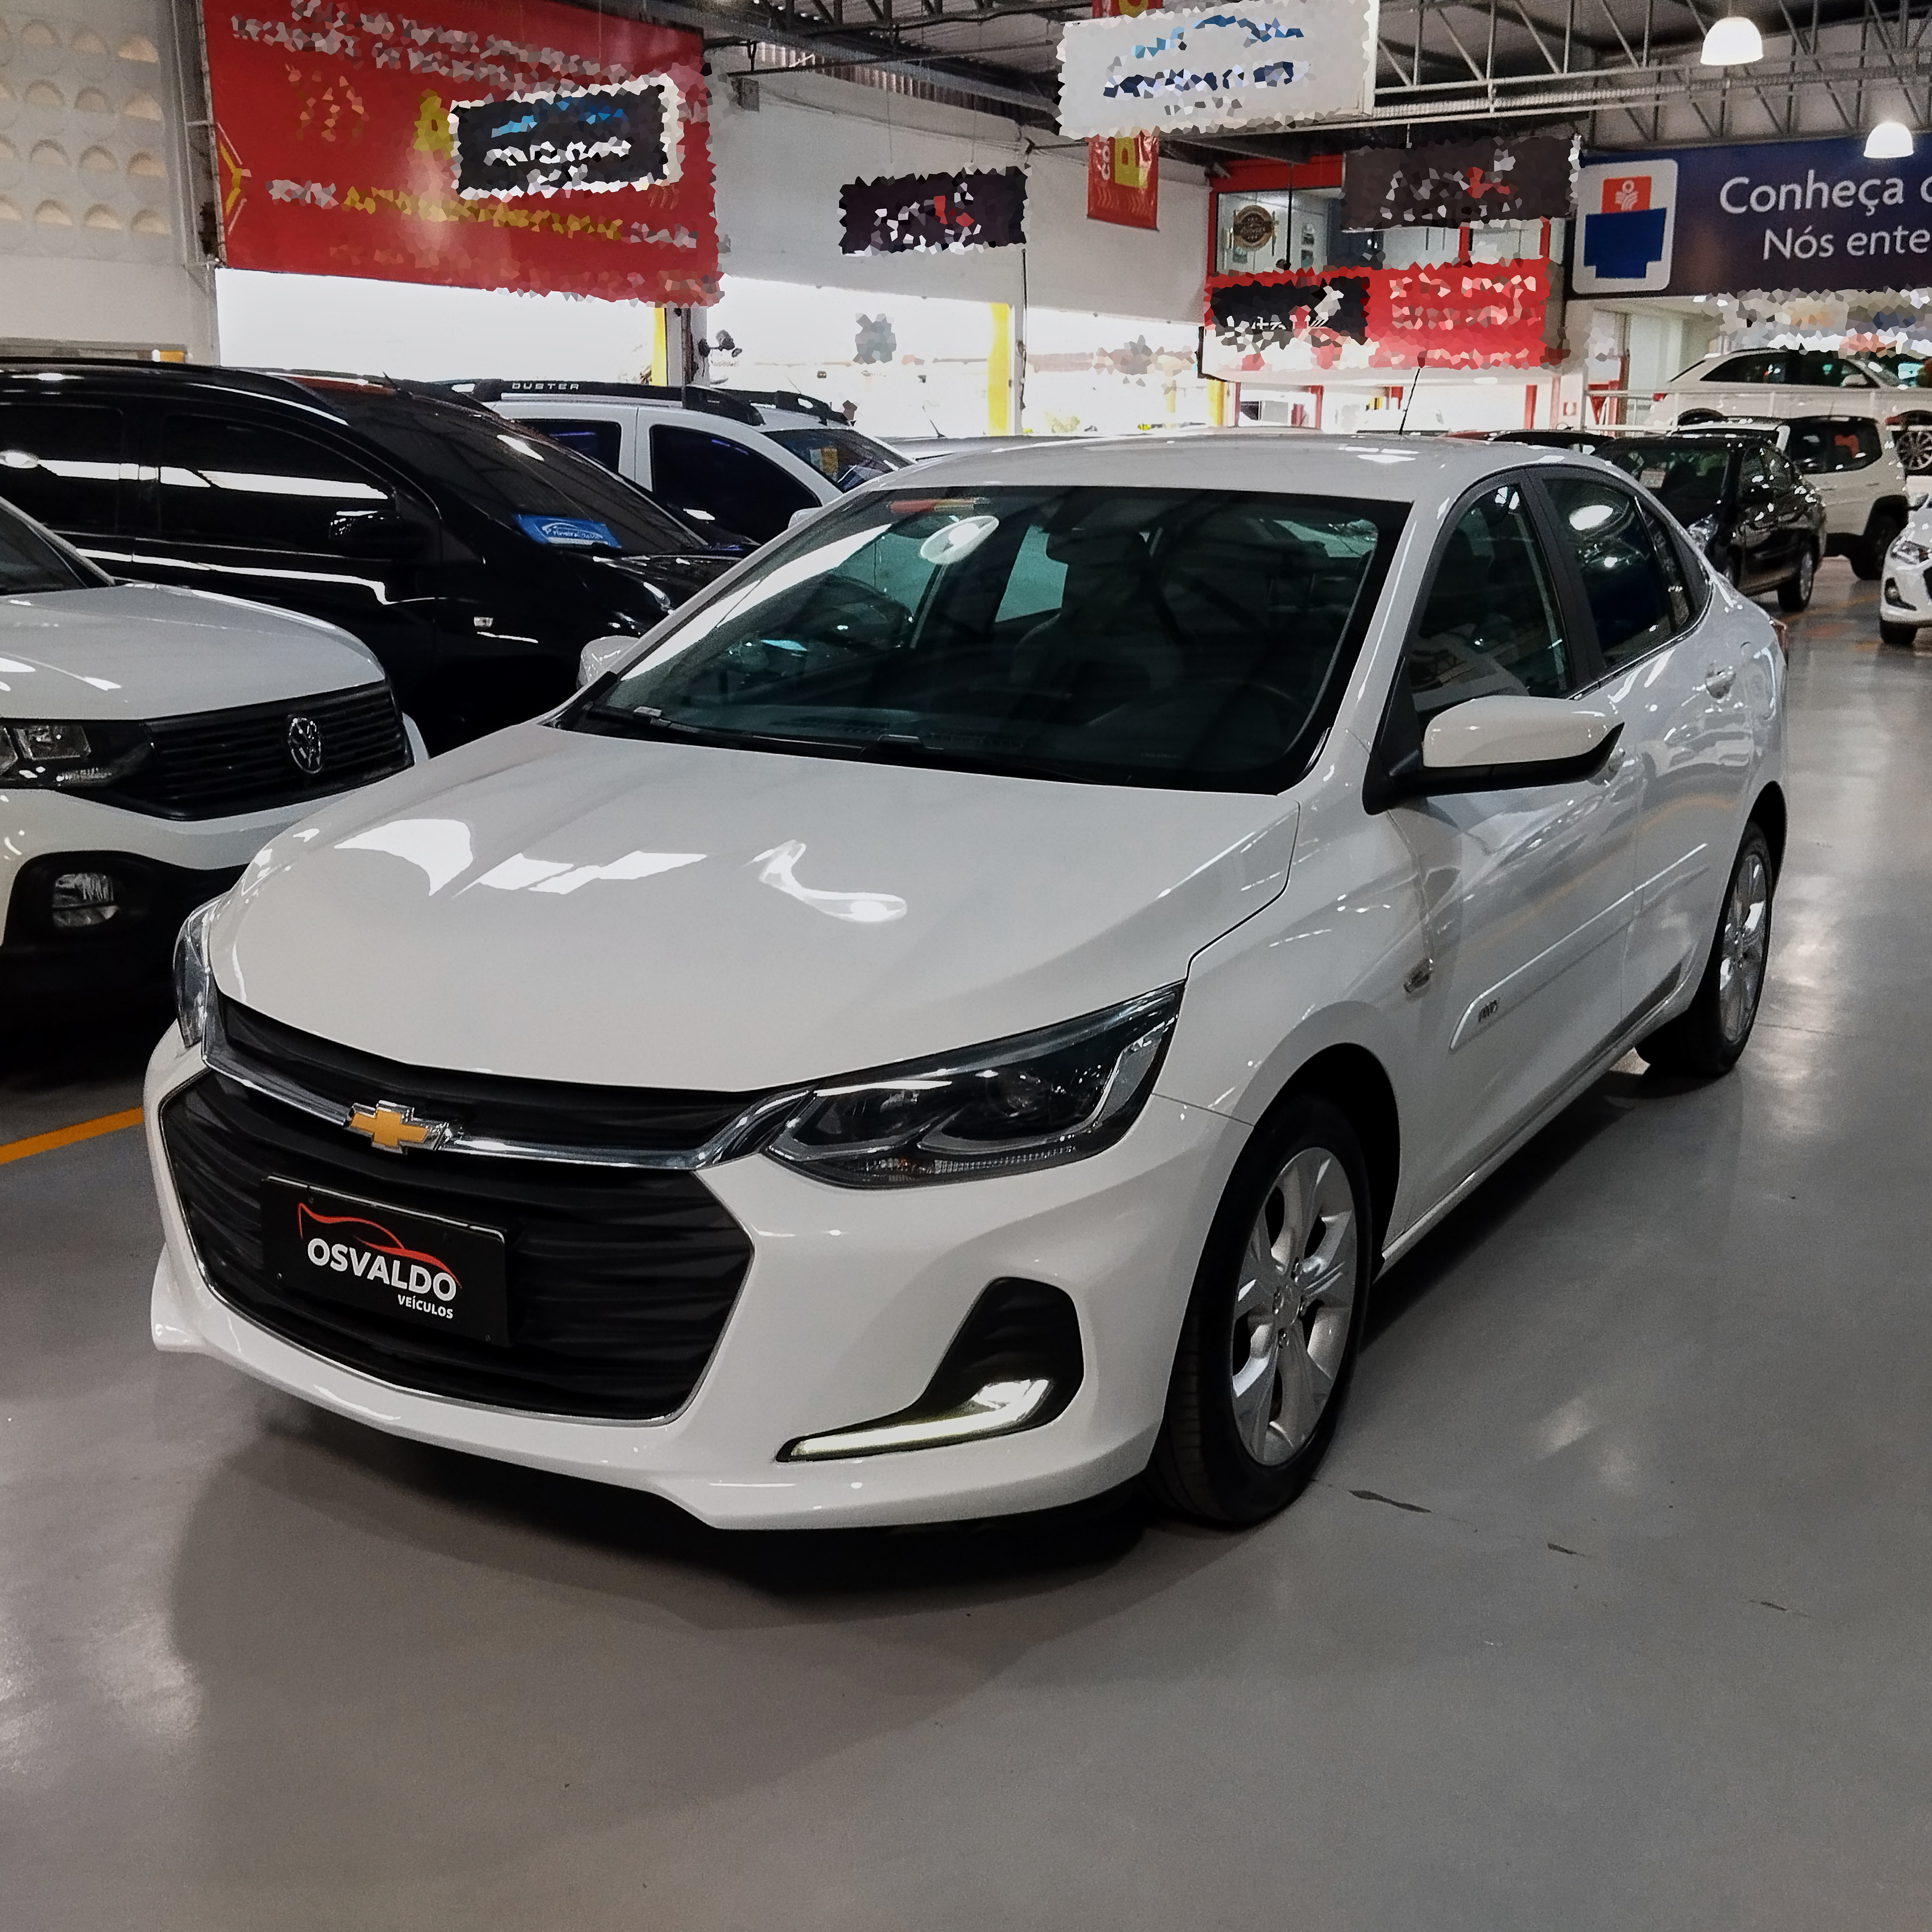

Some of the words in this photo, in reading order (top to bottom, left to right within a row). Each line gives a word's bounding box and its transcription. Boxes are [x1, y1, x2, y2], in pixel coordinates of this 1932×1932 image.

[1719, 169, 1904, 216] Conheça
[1763, 225, 1834, 261] Nós
[1846, 225, 1931, 257] ente
[307, 1238, 457, 1302] OSVALDO
[397, 1294, 454, 1319] VEÍCULOS
